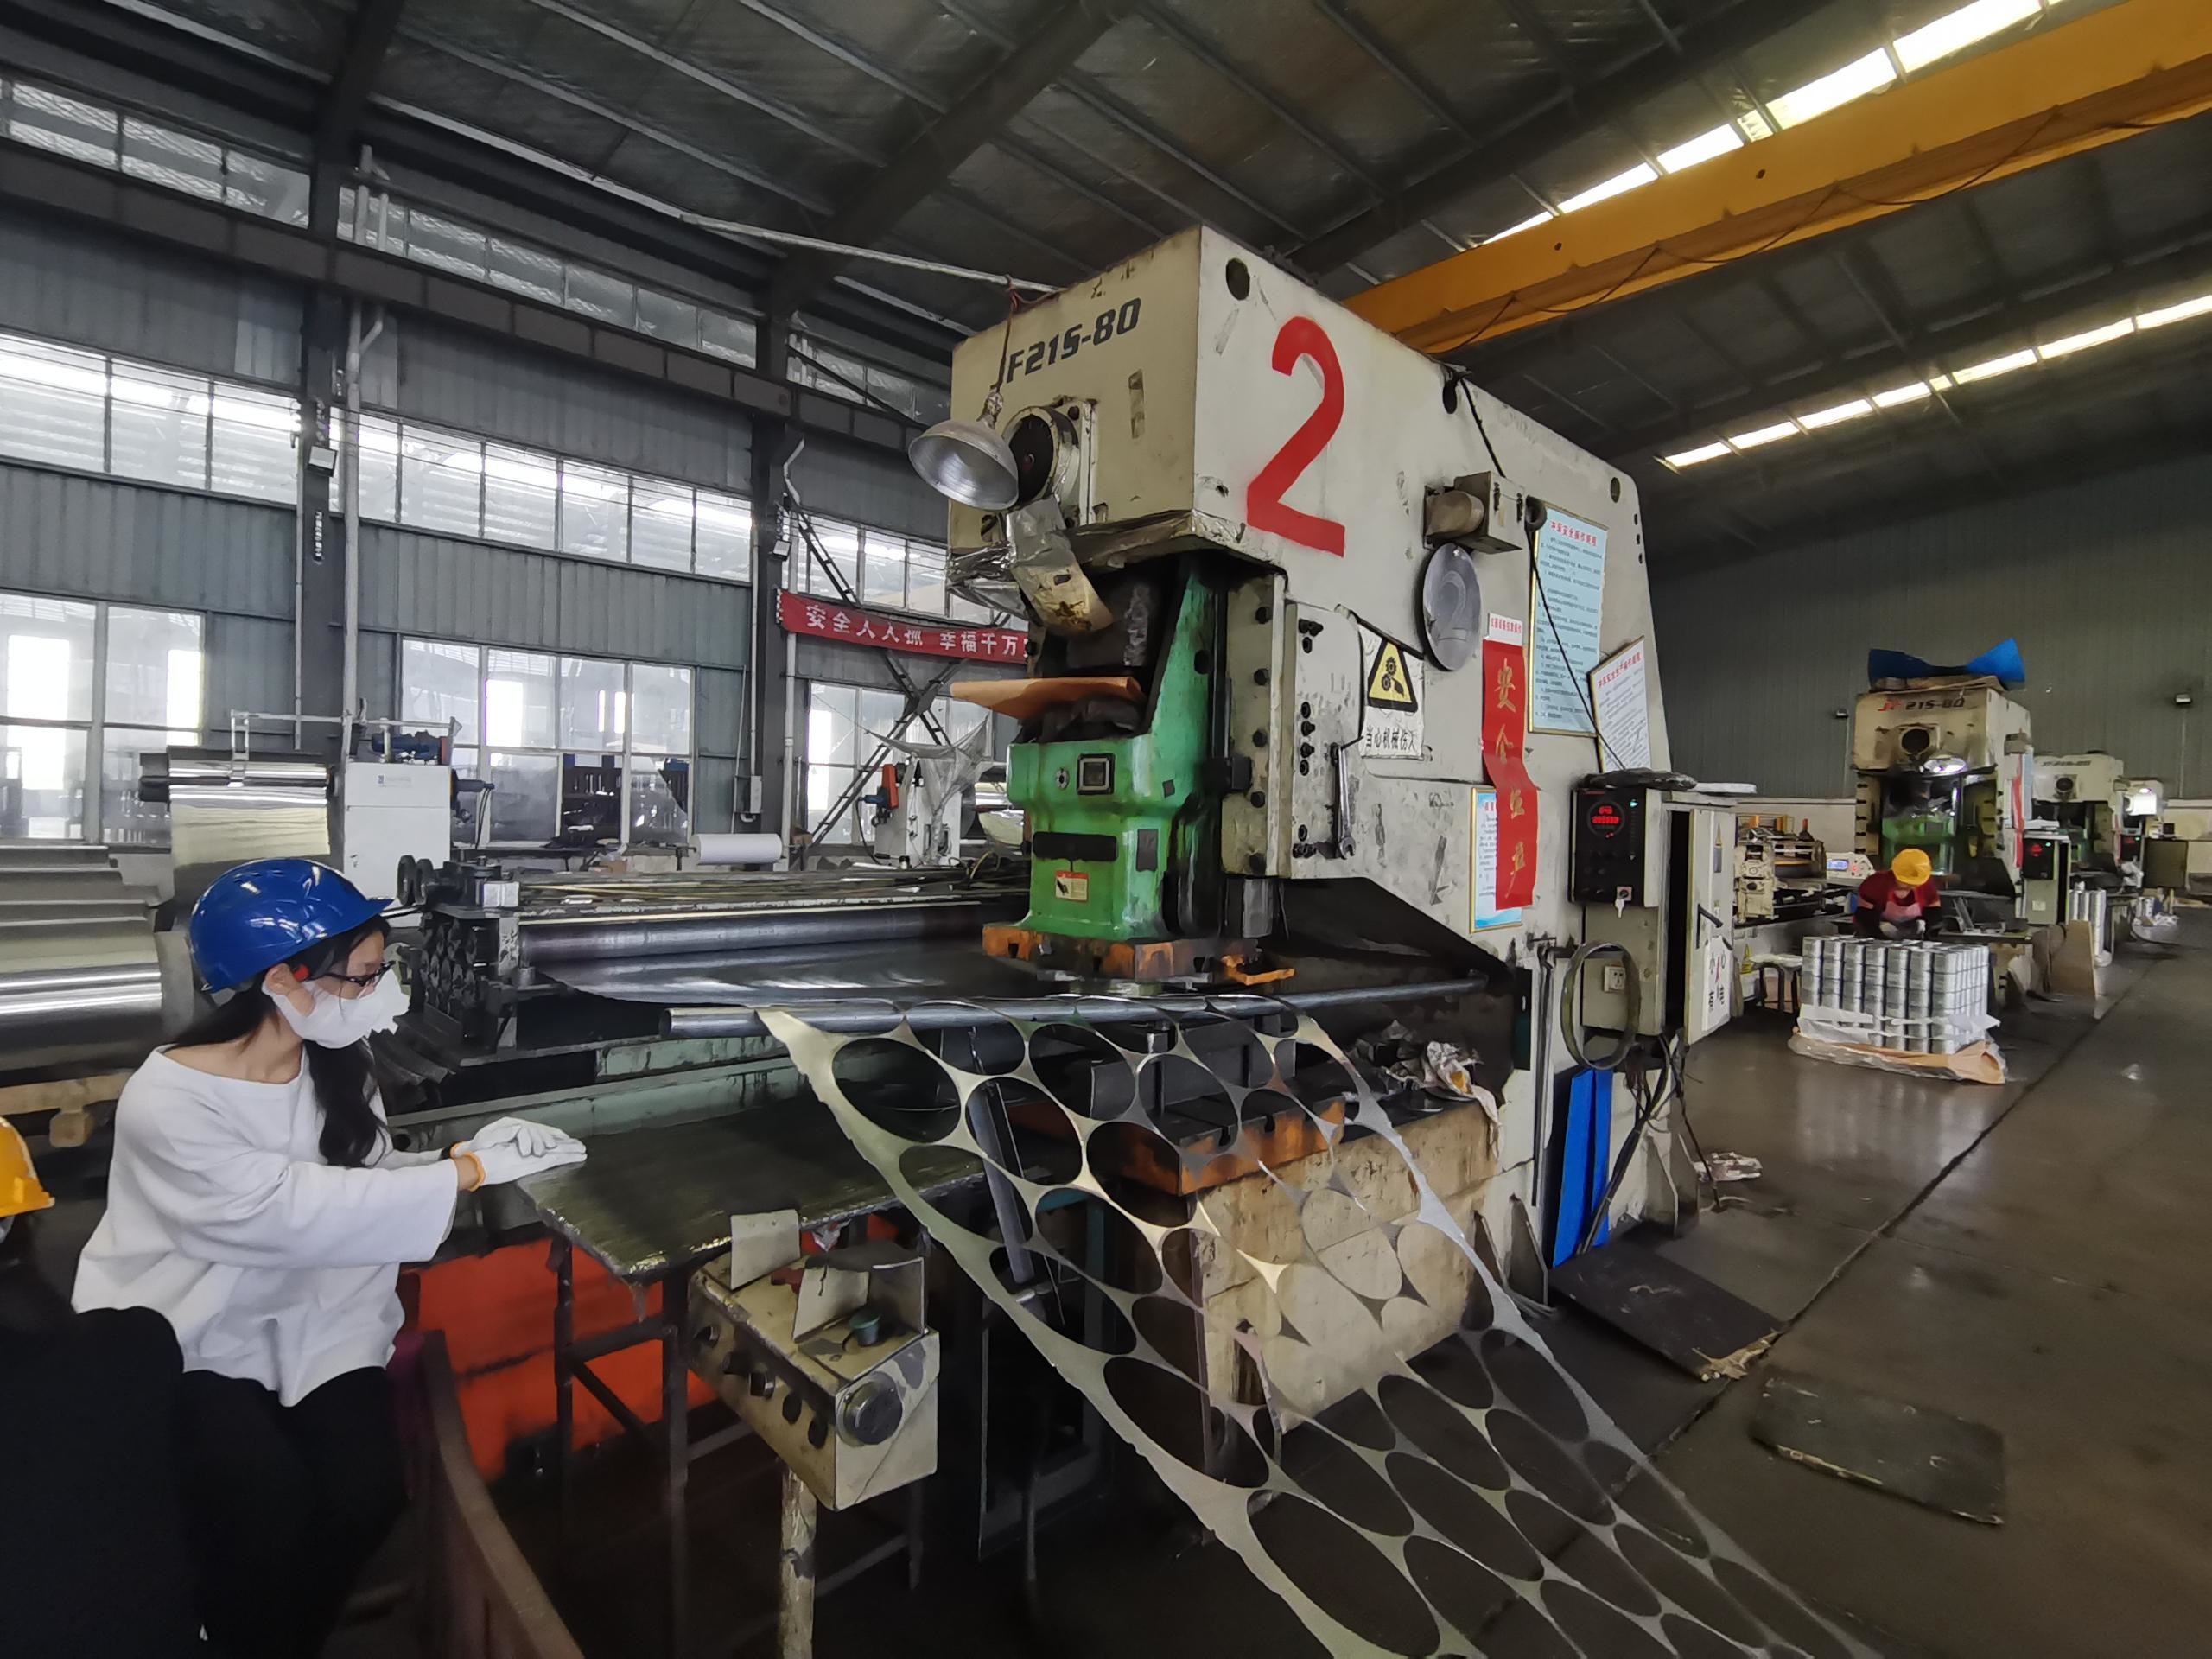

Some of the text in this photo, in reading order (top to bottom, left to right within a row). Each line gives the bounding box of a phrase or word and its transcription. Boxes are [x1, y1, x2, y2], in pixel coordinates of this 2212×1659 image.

[1246, 315, 1345, 558] 2
[940, 630, 1028, 658] 幸福千万
[1365, 724, 1418, 752] 当心机械伤人
